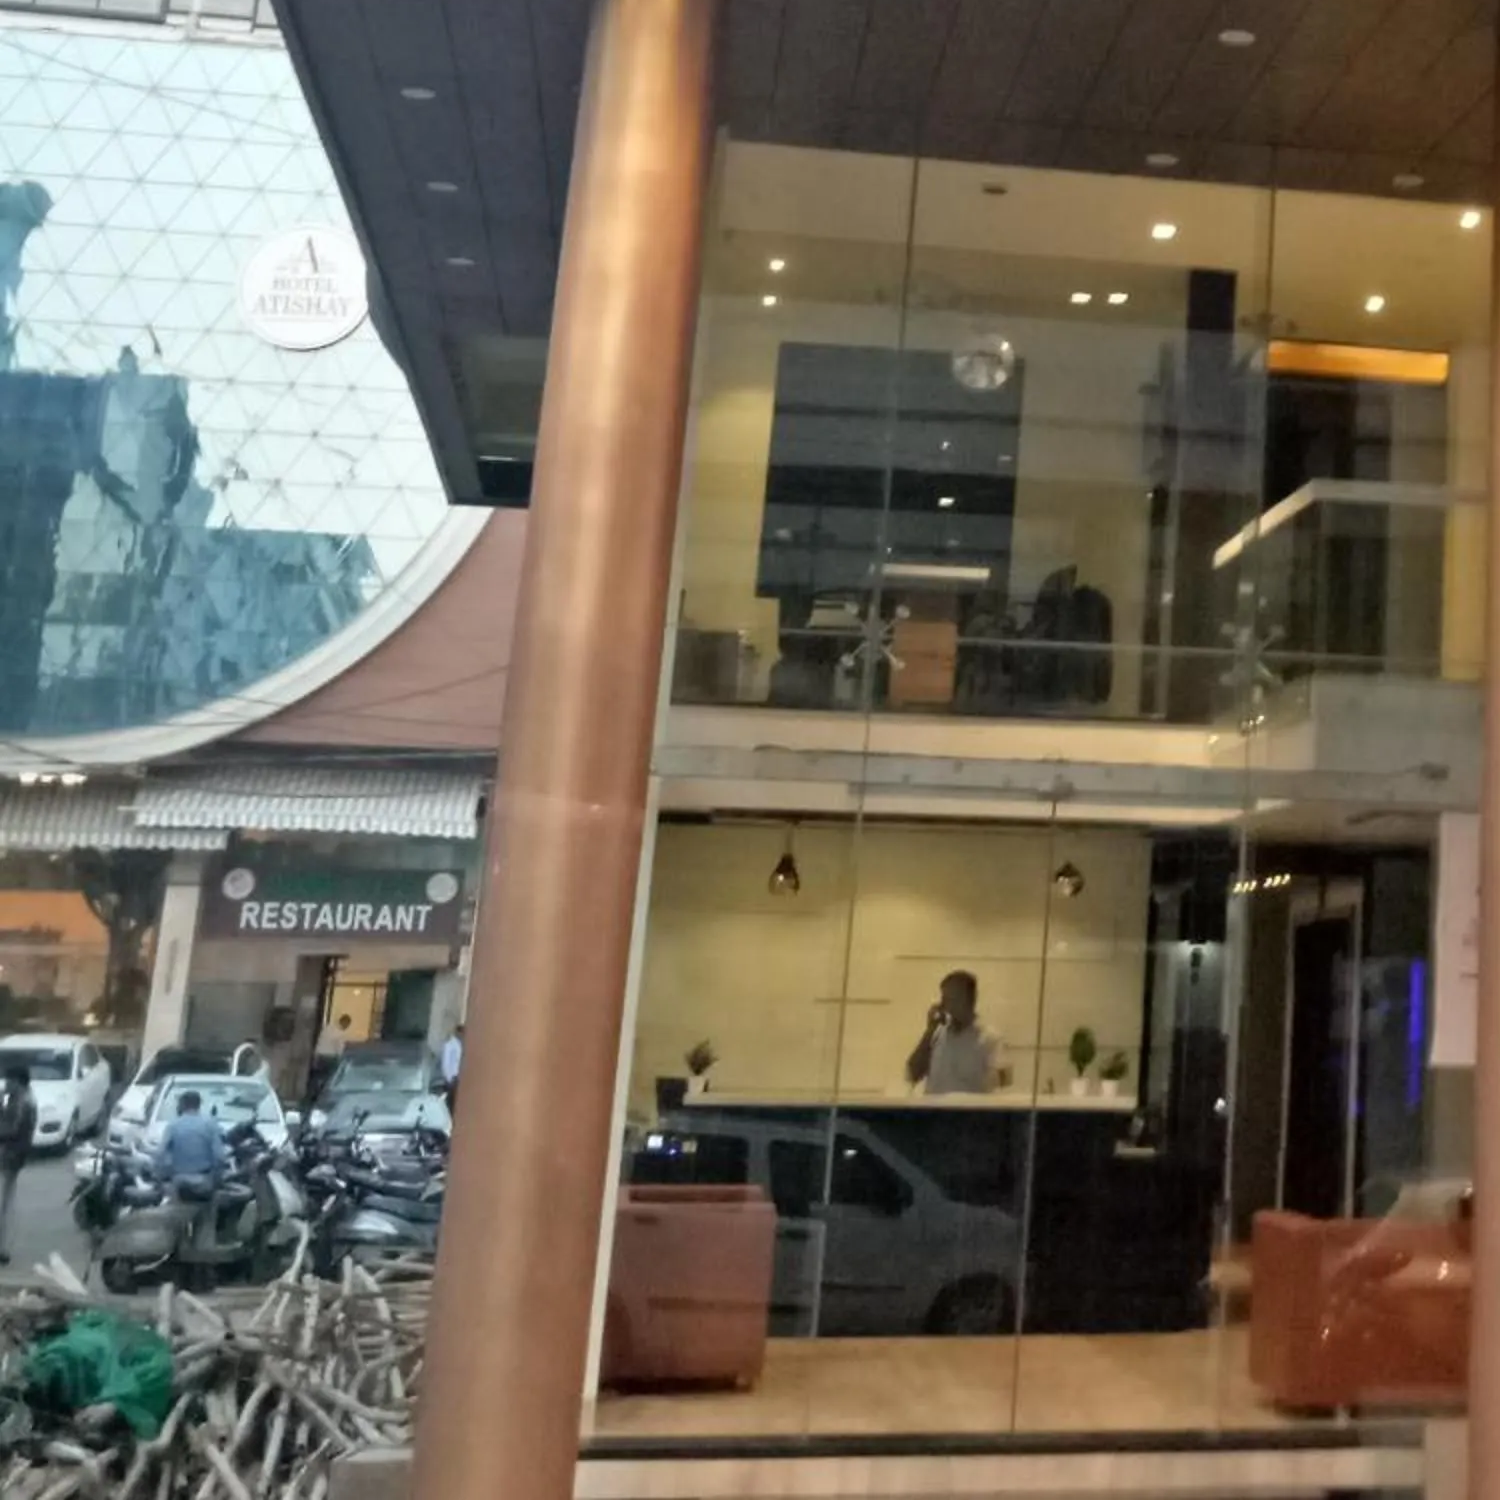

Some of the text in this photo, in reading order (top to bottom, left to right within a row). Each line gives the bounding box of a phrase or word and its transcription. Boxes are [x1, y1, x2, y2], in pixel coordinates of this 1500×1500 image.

[272, 277, 338, 294] HOTEL
[251, 294, 354, 318] ATISHAY
[239, 901, 433, 932] RESTAURANT
